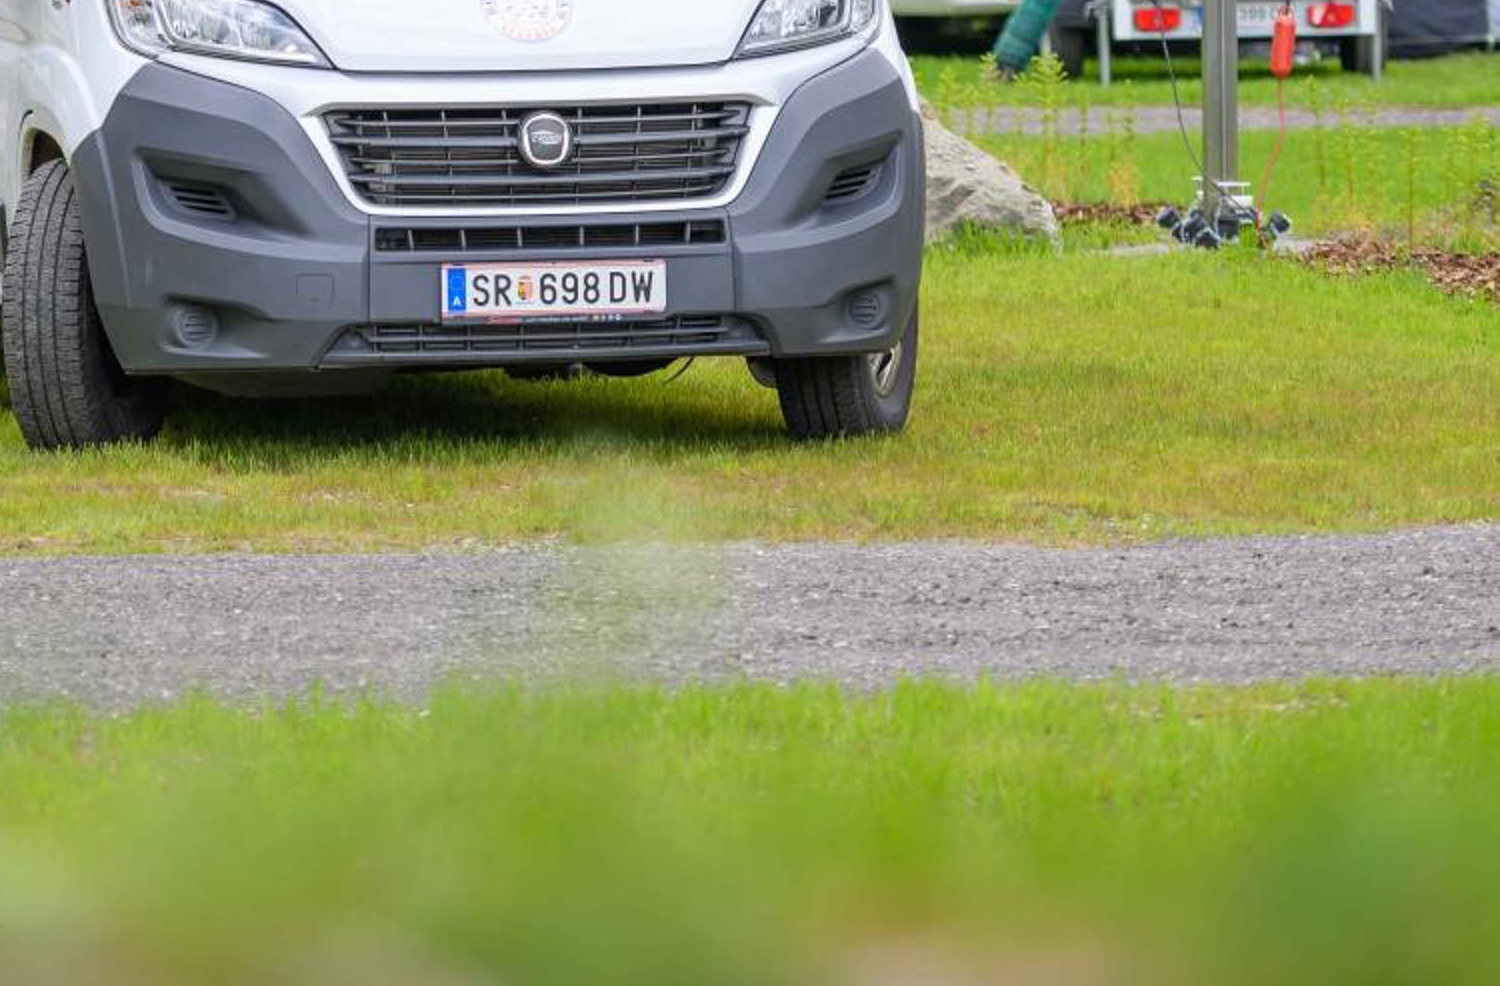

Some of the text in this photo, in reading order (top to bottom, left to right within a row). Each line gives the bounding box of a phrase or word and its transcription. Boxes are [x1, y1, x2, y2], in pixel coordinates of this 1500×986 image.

[453, 295, 461, 306] A
[472, 270, 654, 307] SR 698 DW
